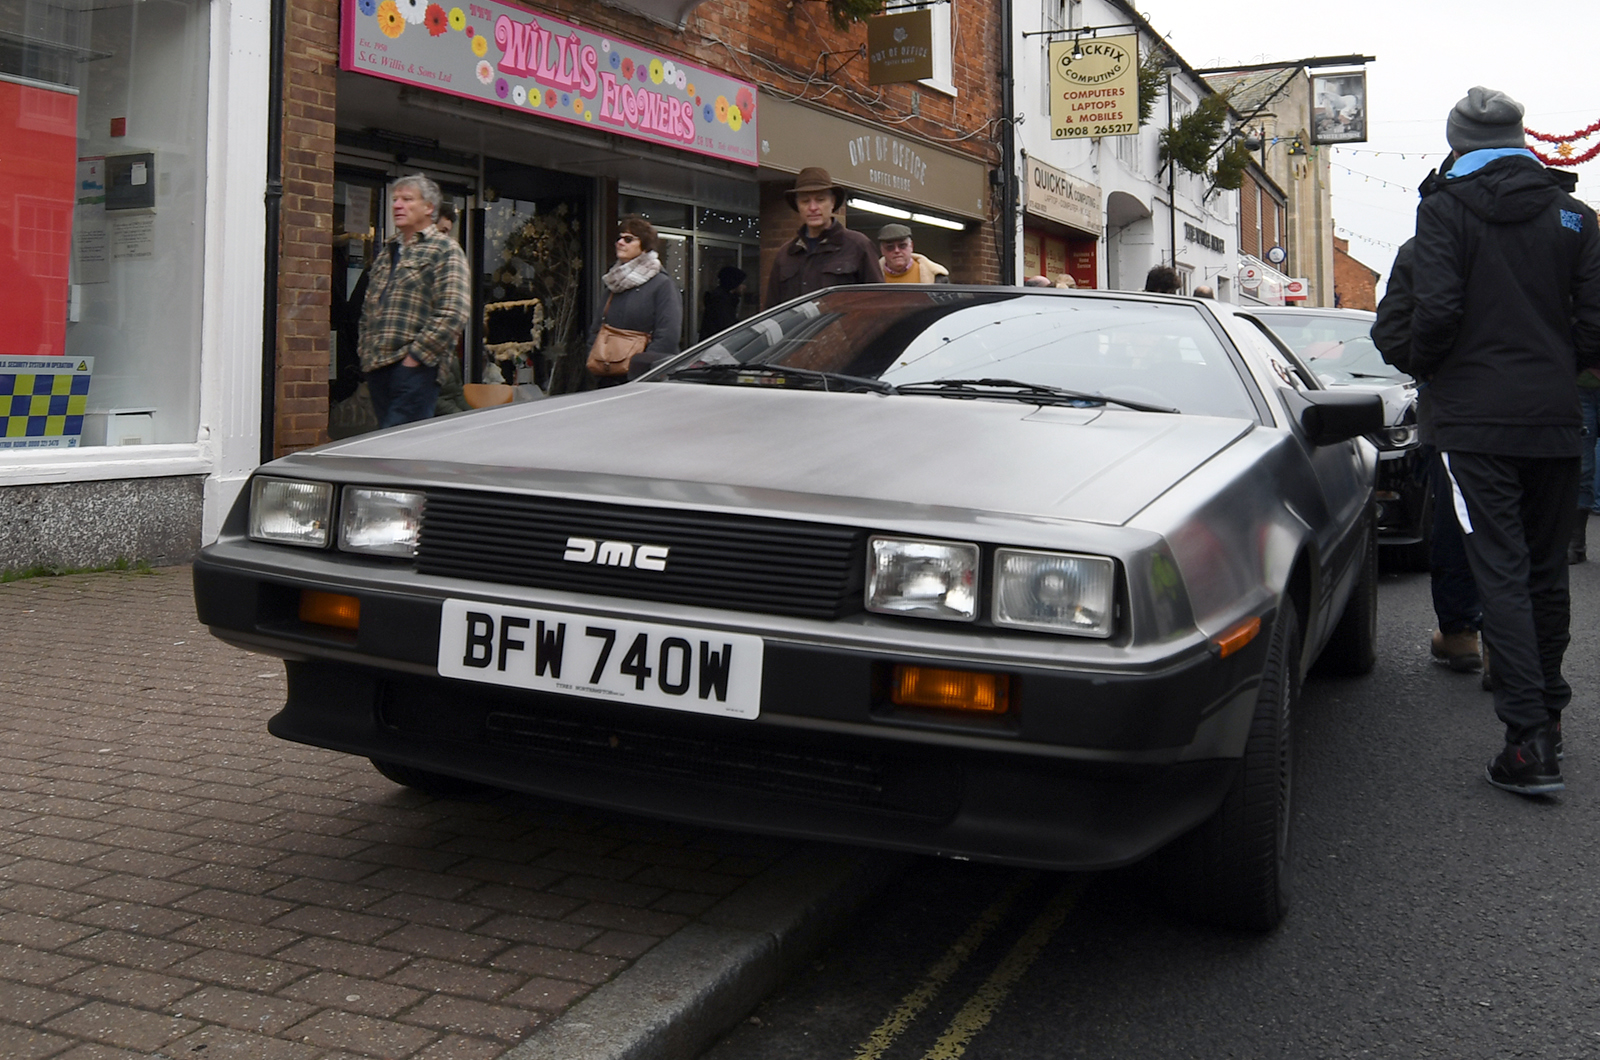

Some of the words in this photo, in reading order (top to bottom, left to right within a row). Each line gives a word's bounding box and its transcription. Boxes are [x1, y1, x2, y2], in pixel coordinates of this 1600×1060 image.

[495, 14, 598, 99] WILLIS
[871, 50, 886, 63] OUT
[889, 47, 898, 58] OF
[901, 46, 928, 58] OFFICE
[1061, 44, 1124, 67] QICKFIX
[381, 56, 405, 71] Willis
[407, 64, 415, 74] &
[418, 66, 436, 79] Sons
[438, 71, 452, 83] Ltd
[1065, 64, 1121, 83] COMPUTING
[1063, 87, 1125, 100] COMPUTERS
[599, 71, 696, 144] FLOWERS
[1071, 100, 1117, 111] LAPTOPS
[1066, 115, 1073, 123] &
[1079, 111, 1123, 123] MOBILES
[1055, 126, 1089, 137] 01908
[1093, 123, 1134, 135] 265217
[849, 135, 871, 167] OUT
[875, 136, 888, 161] OF
[892, 140, 927, 186] OFFICE
[869, 168, 892, 187] COFFEE
[1034, 166, 1074, 200] QUICKFIX
[463, 611, 567, 680] BFW
[585, 626, 733, 703] 740W
